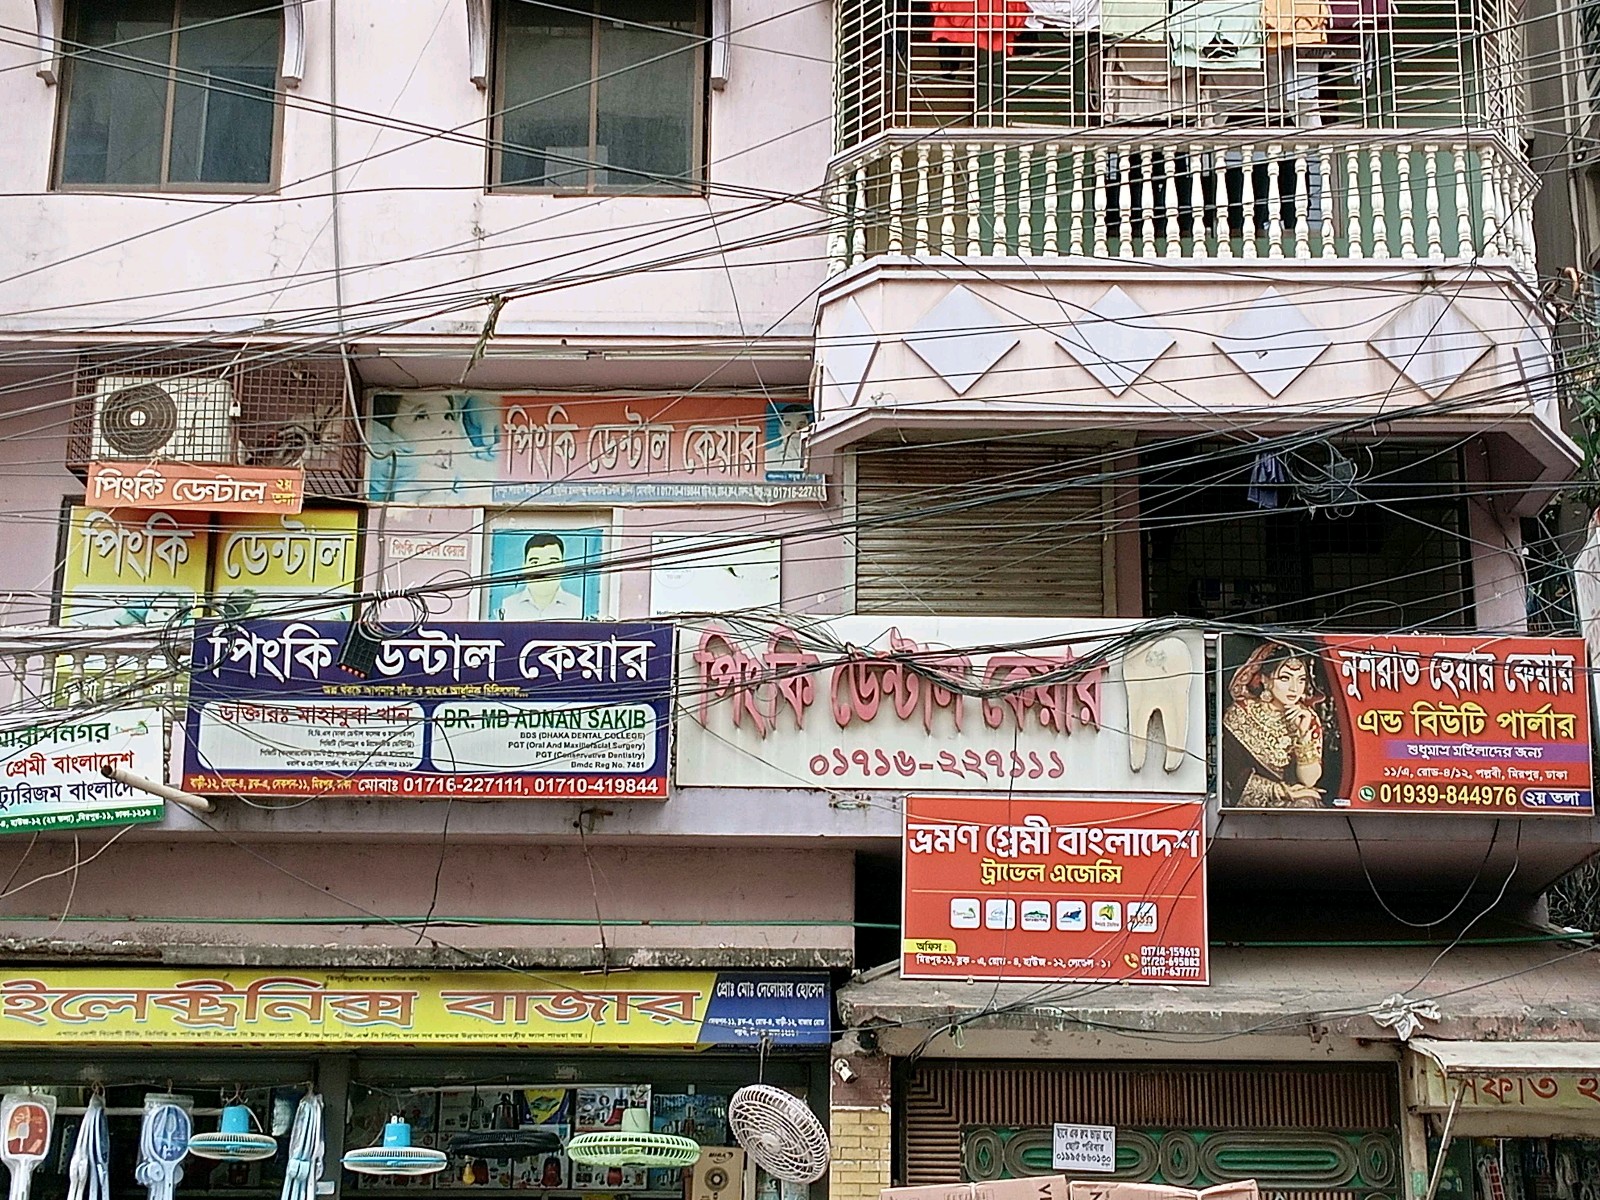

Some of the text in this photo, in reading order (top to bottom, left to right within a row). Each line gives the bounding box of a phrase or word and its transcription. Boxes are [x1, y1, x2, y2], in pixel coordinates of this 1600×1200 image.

[504, 405, 761, 478] পিংকি ডেন্টাল কেয়ার
[95, 468, 267, 503] পিংকি ডেন্টাল
[80, 512, 355, 582] পিংকি ডেন্টাল
[207, 622, 338, 682] পিংকি
[518, 622, 656, 682] কেয়ার
[693, 624, 1109, 740] পিংকি ডেন্টাল কেয়ার
[1338, 646, 1575, 701] নুশরাত হেয়ার কেয়ার
[444, 709, 646, 729] DR. MD ADNAN SAKIB
[1410, 701, 1487, 737] বিউটি
[1497, 703, 1577, 739] পার্লার
[547, 741, 562, 749] And
[1407, 743, 1543, 760] শুধুমাত্র মহিলাদের জন্য
[6, 752, 47, 777] প্রেমী
[595, 762, 611, 770] Reg
[810, 748, 1065, 781] ০১৭১৬-২২৭১১১
[1545, 770, 1568, 781] ঢাকা
[403, 777, 529, 795] 01716-227111,
[534, 778, 658, 793] 01710-419844
[1380, 784, 1517, 806] 01939-844976
[1525, 792, 1579, 806] ২য় তলা
[908, 816, 1200, 858] ভ্রমণ প্রেমী বাংলাদেশ
[981, 857, 1122, 885] ট্রাভেল এজেন্সি
[916, 941, 942, 952] অফিস
[796, 983, 825, 999] হোসেন
[440, 990, 705, 1026] বাজার
